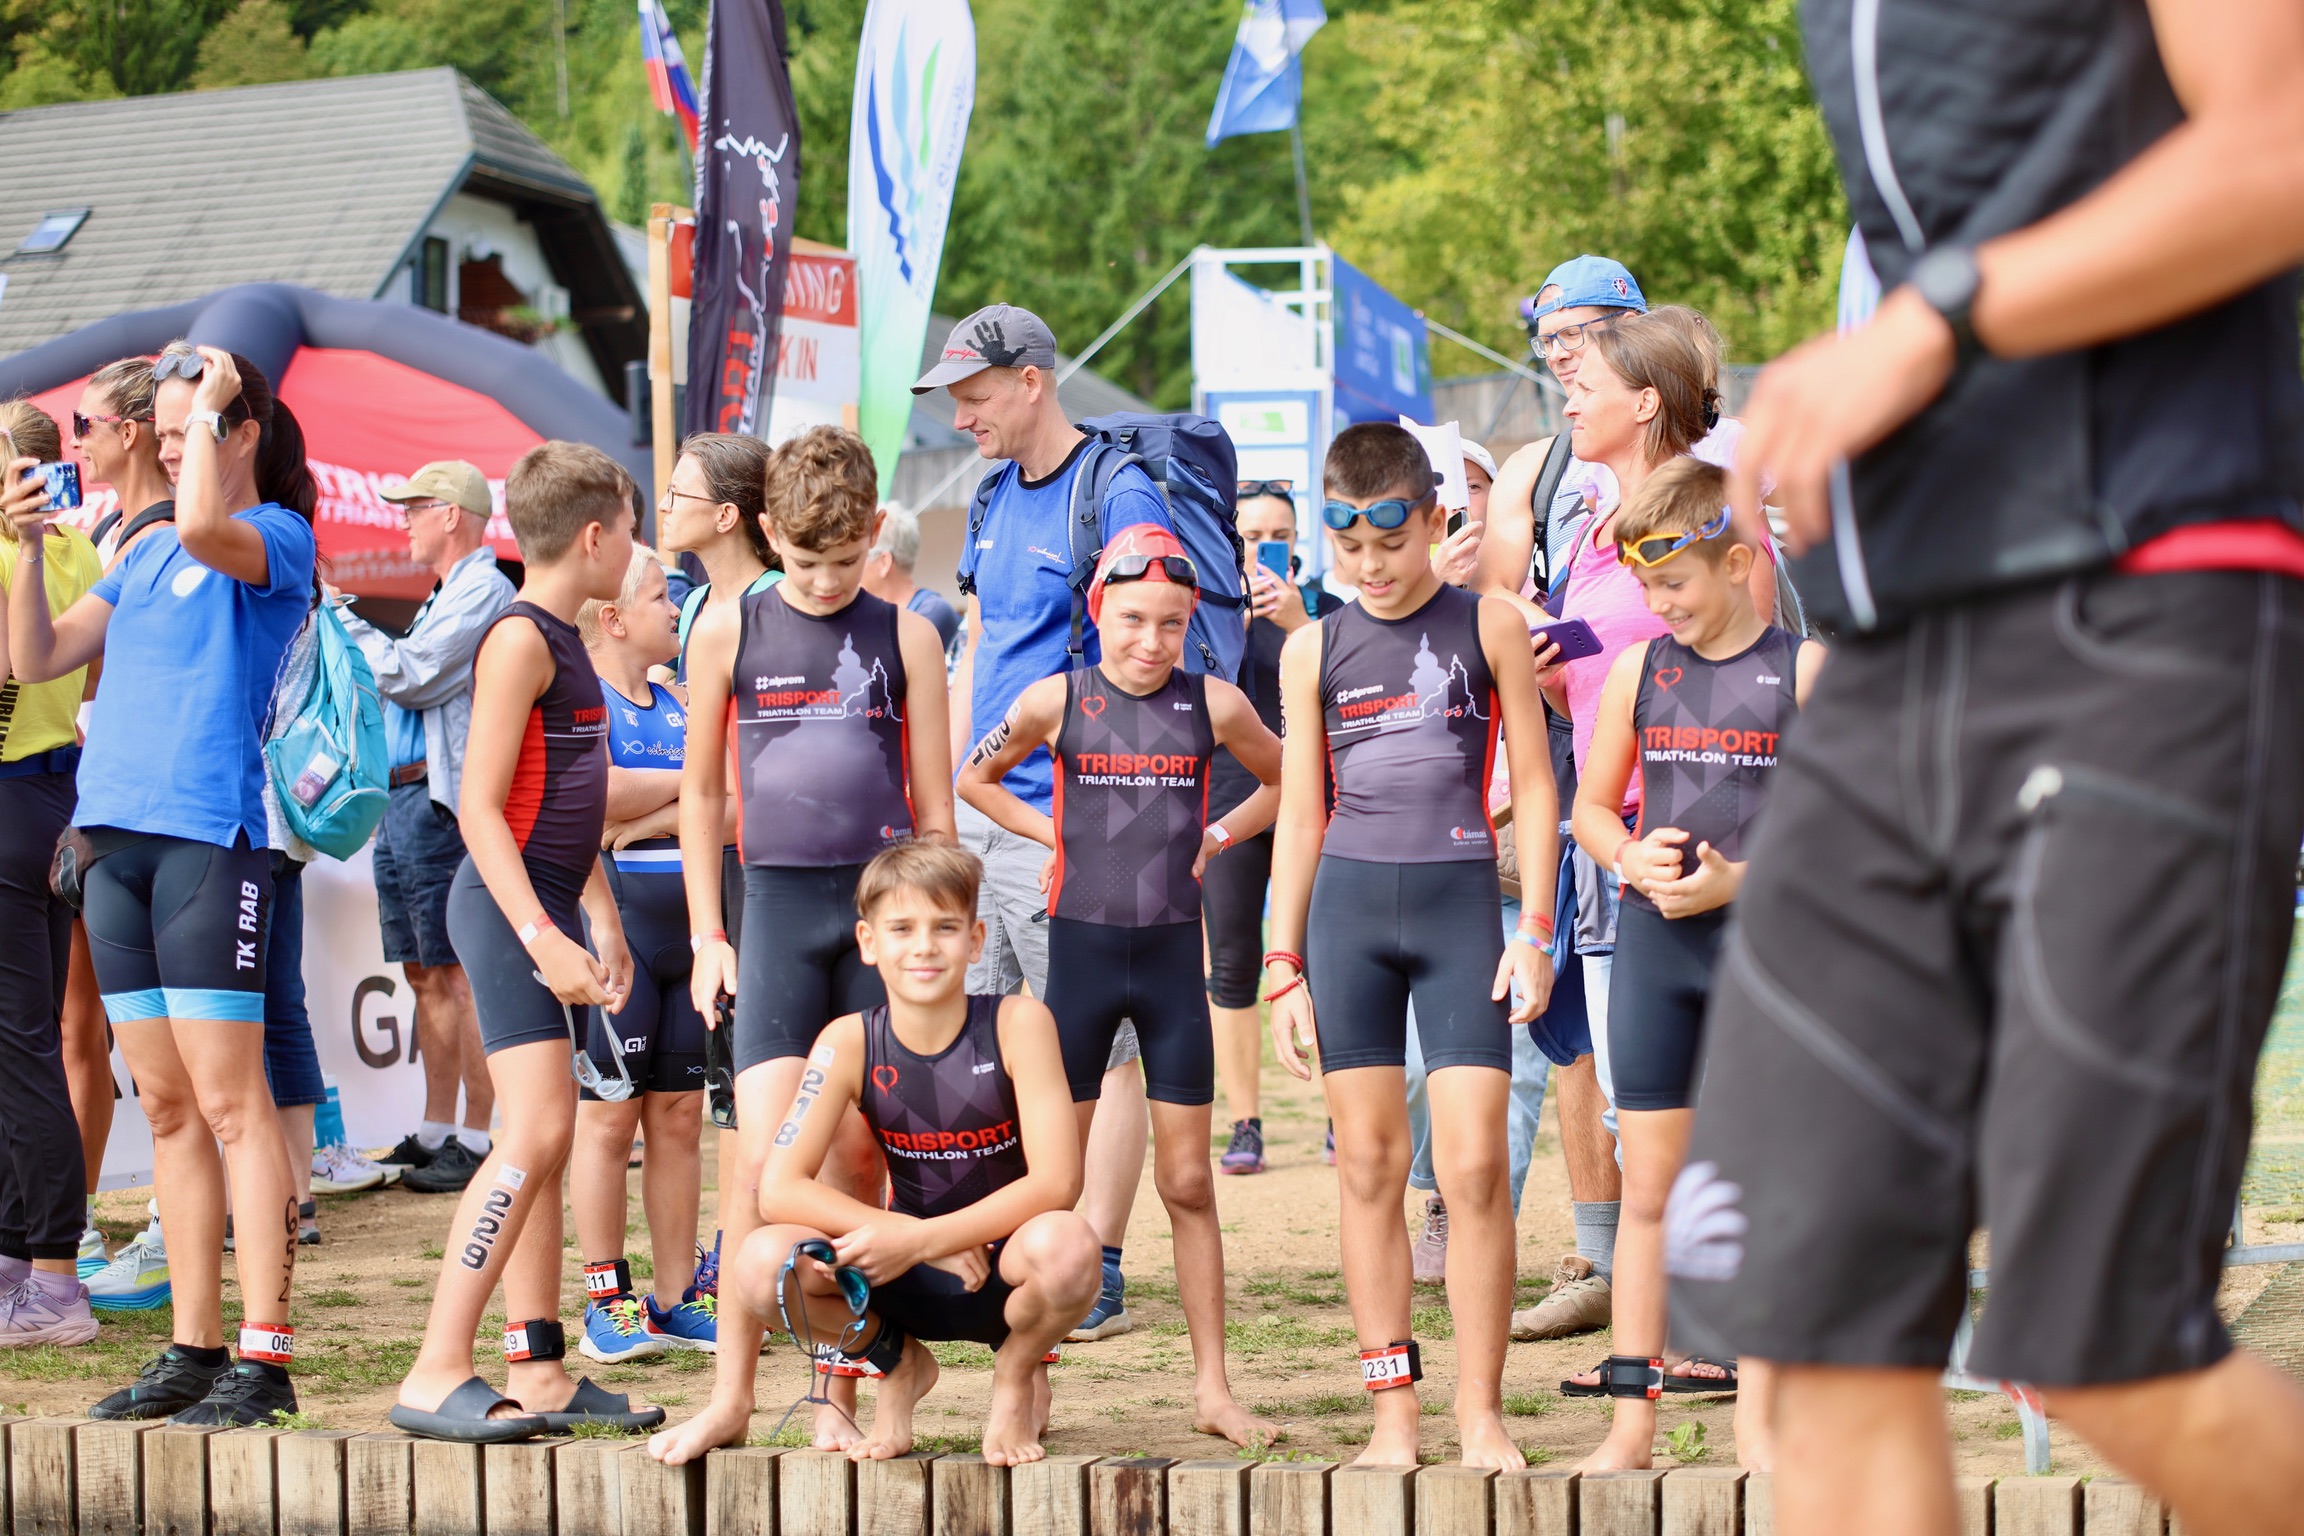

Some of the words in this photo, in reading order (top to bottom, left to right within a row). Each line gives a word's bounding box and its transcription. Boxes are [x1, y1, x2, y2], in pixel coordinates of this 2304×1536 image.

[756, 690, 843, 708] TRISPORT
[1338, 694, 1420, 720] TRISPORT
[757, 708, 811, 718] TRIATHLON
[814, 707, 843, 716] TEAM
[1341, 713, 1391, 730] TRIATHLON
[1393, 709, 1421, 720] TEAM
[1644, 725, 1780, 755] TRISPORT
[1076, 753, 1199, 776] TRISPORT
[1645, 751, 1727, 765] TRIATHLON
[1732, 754, 1778, 768] TEAM
[1077, 774, 1157, 787] TRIATHLON
[1160, 776, 1195, 788] TEAM
[239, 880, 259, 933] RAB
[236, 939, 257, 971] TK
[774, 1068, 825, 1148] 218
[879, 1119, 1013, 1151] TRISPORT
[885, 1142, 968, 1161] TRIATHLON
[974, 1136, 1018, 1158] TEAM
[460, 1188, 513, 1271] 229
[277, 1195, 298, 1302] 652
